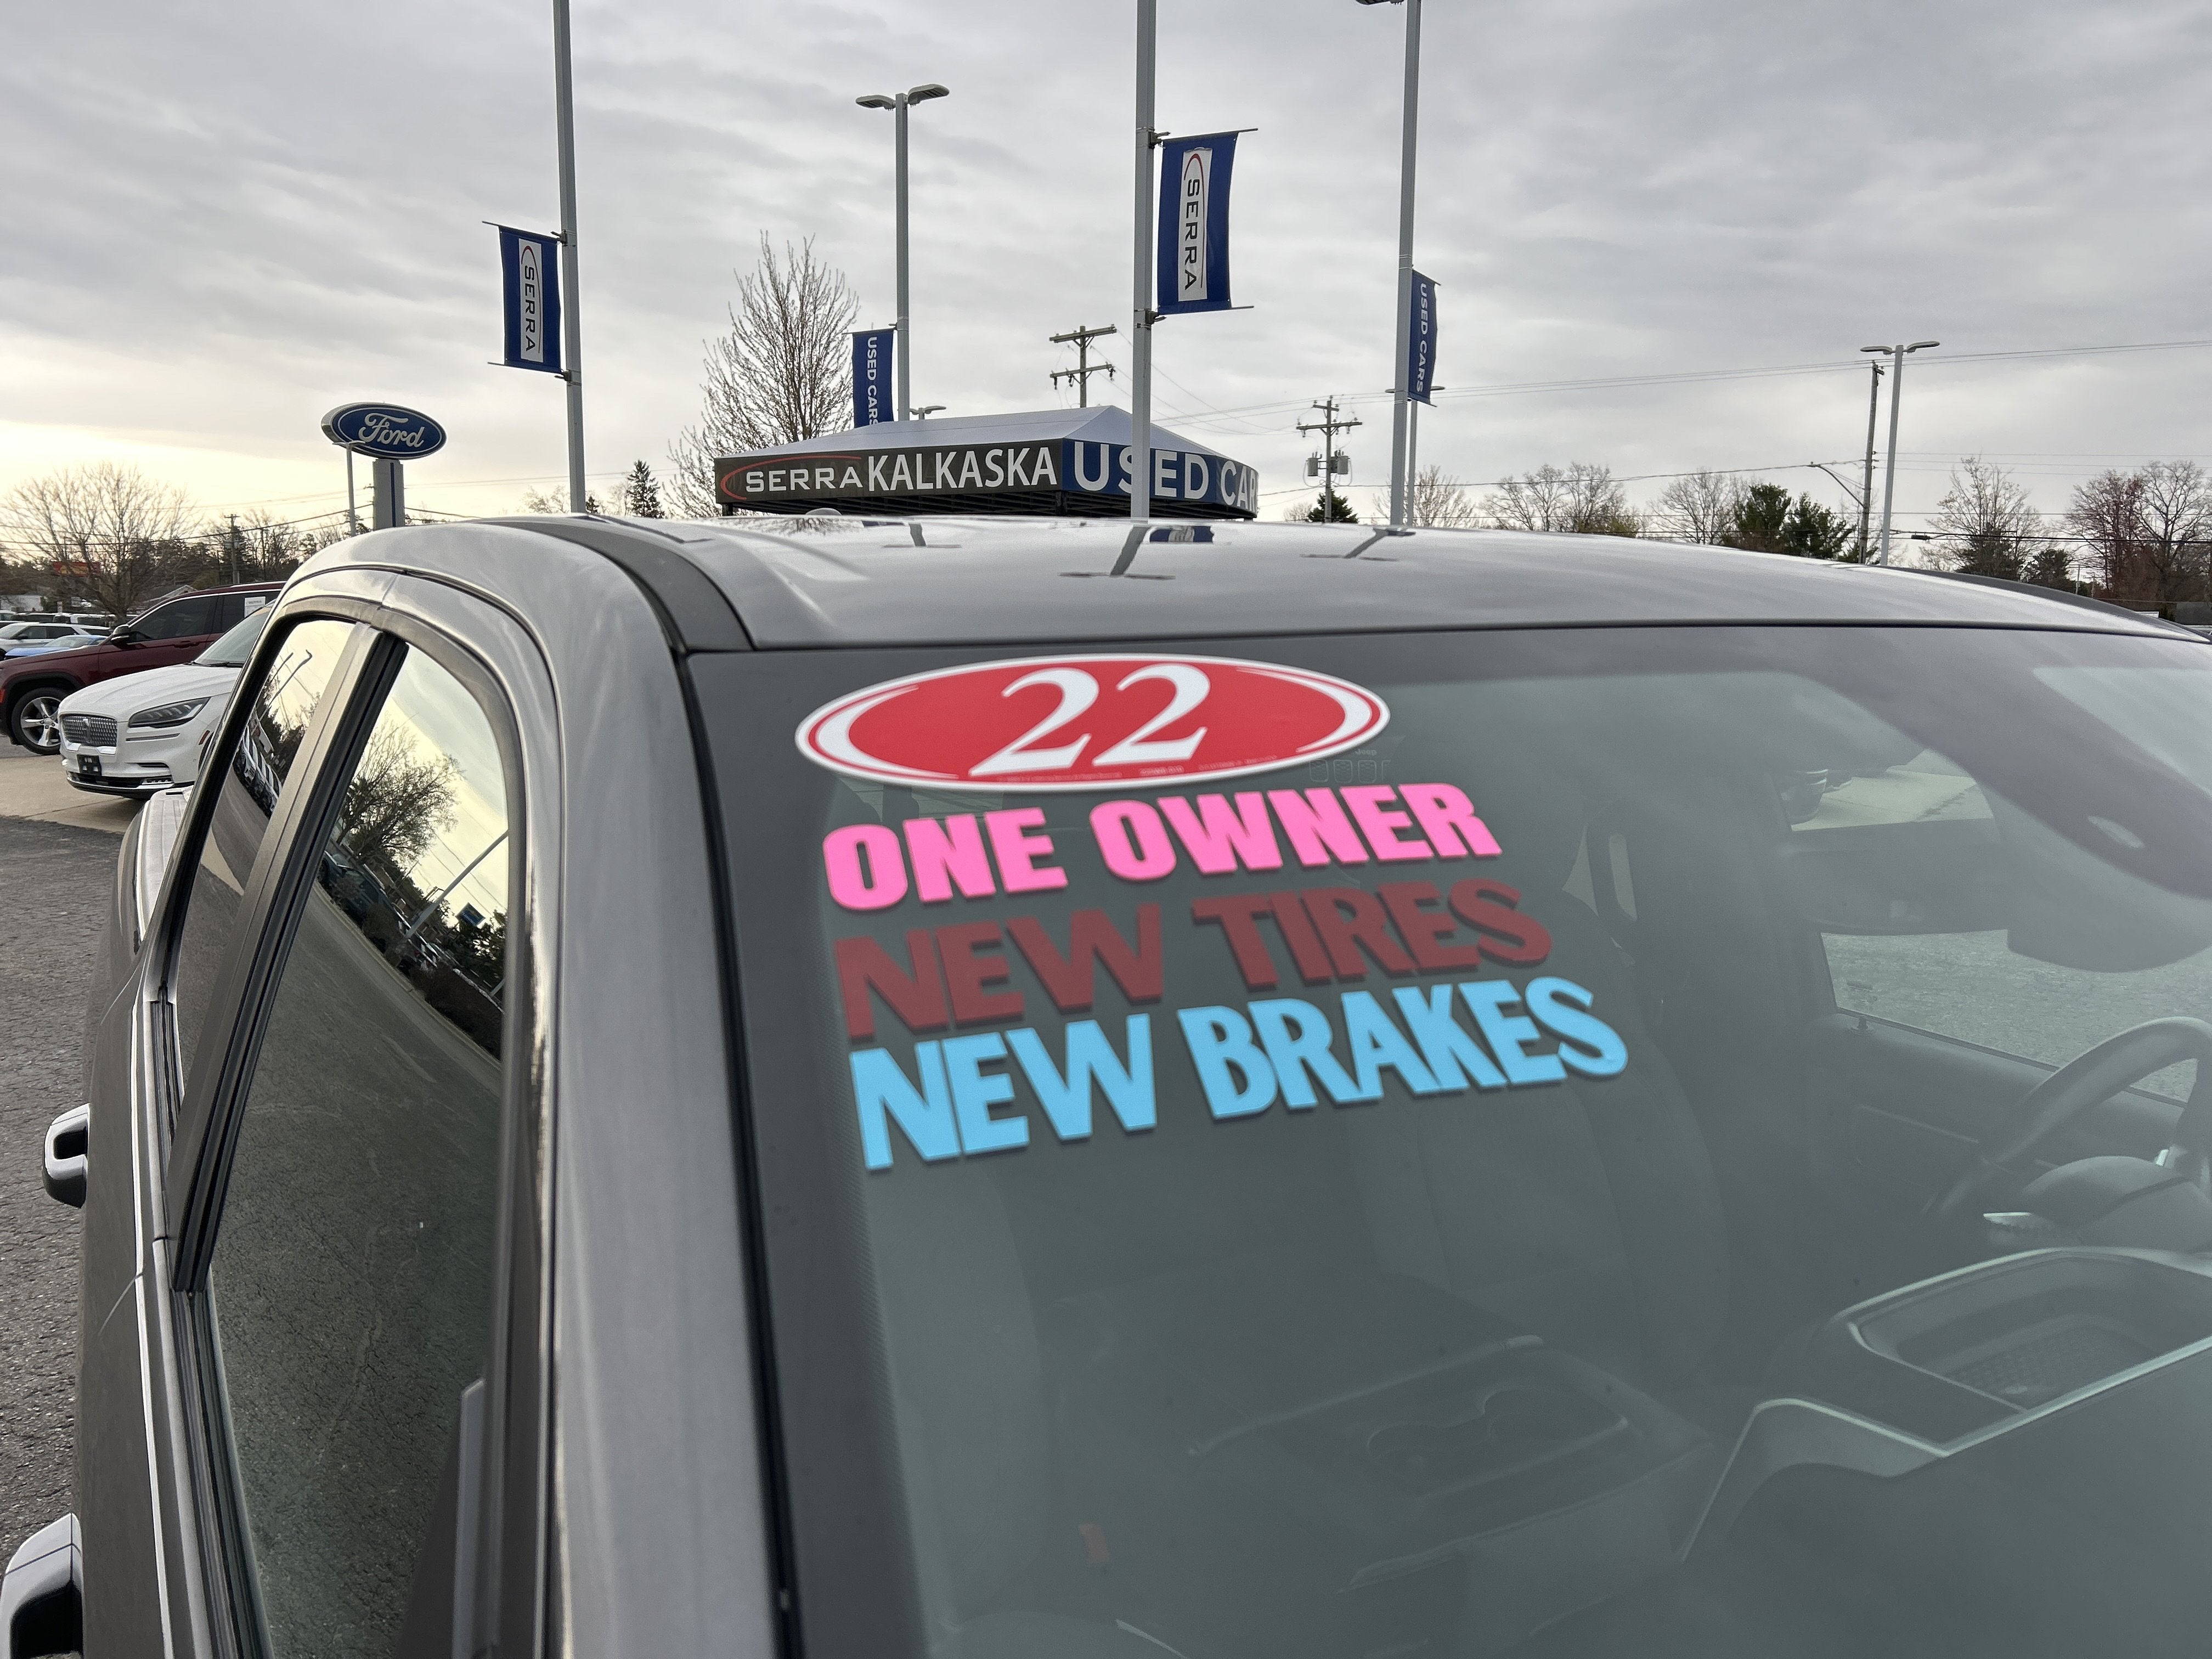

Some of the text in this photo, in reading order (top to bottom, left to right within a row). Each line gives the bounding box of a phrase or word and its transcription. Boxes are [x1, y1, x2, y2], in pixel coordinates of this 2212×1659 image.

[1184, 179, 1200, 290] SERRA
[524, 265, 535, 352] SERRA
[1416, 283, 1428, 393] USED CARS
[358, 413, 425, 448] Ford
[867, 337, 878, 425] USED CARS
[746, 447, 1058, 493] SERRA KALKASKA
[1220, 460, 1257, 514] CAR
[968, 663, 1211, 777] 22
[823, 783, 1503, 911] ONE OWNER
[834, 878, 1553, 1038] NEW TIRES
[850, 977, 1628, 1170] NEW BRAKES
